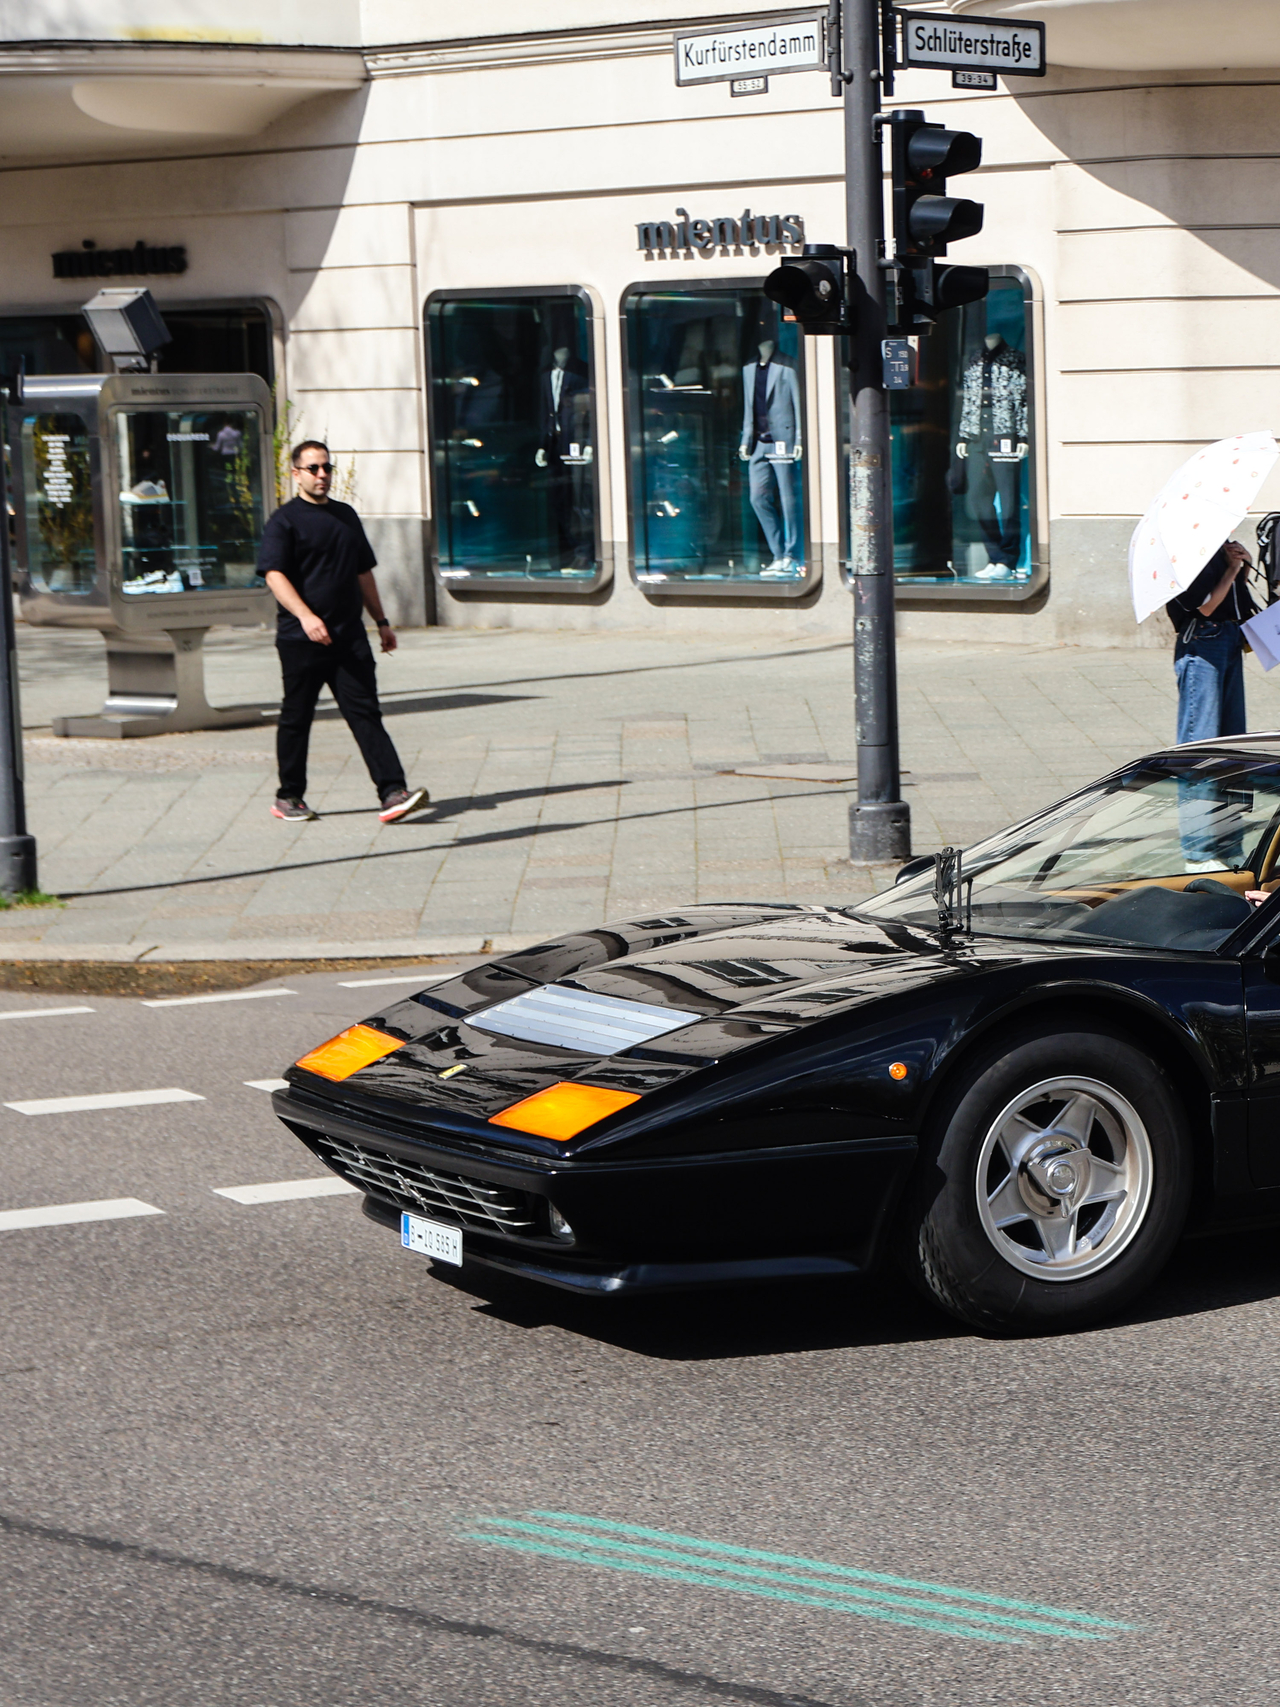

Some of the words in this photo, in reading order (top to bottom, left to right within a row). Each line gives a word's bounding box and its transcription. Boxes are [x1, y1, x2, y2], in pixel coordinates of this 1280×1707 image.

[683, 32, 816, 68] Kurfürstendamm
[914, 27, 1032, 63] Schlüterstraße
[737, 79, 762, 91] 55-52
[960, 74, 989, 84] 39-34
[635, 207, 803, 249] mientus
[52, 239, 188, 278] mientus
